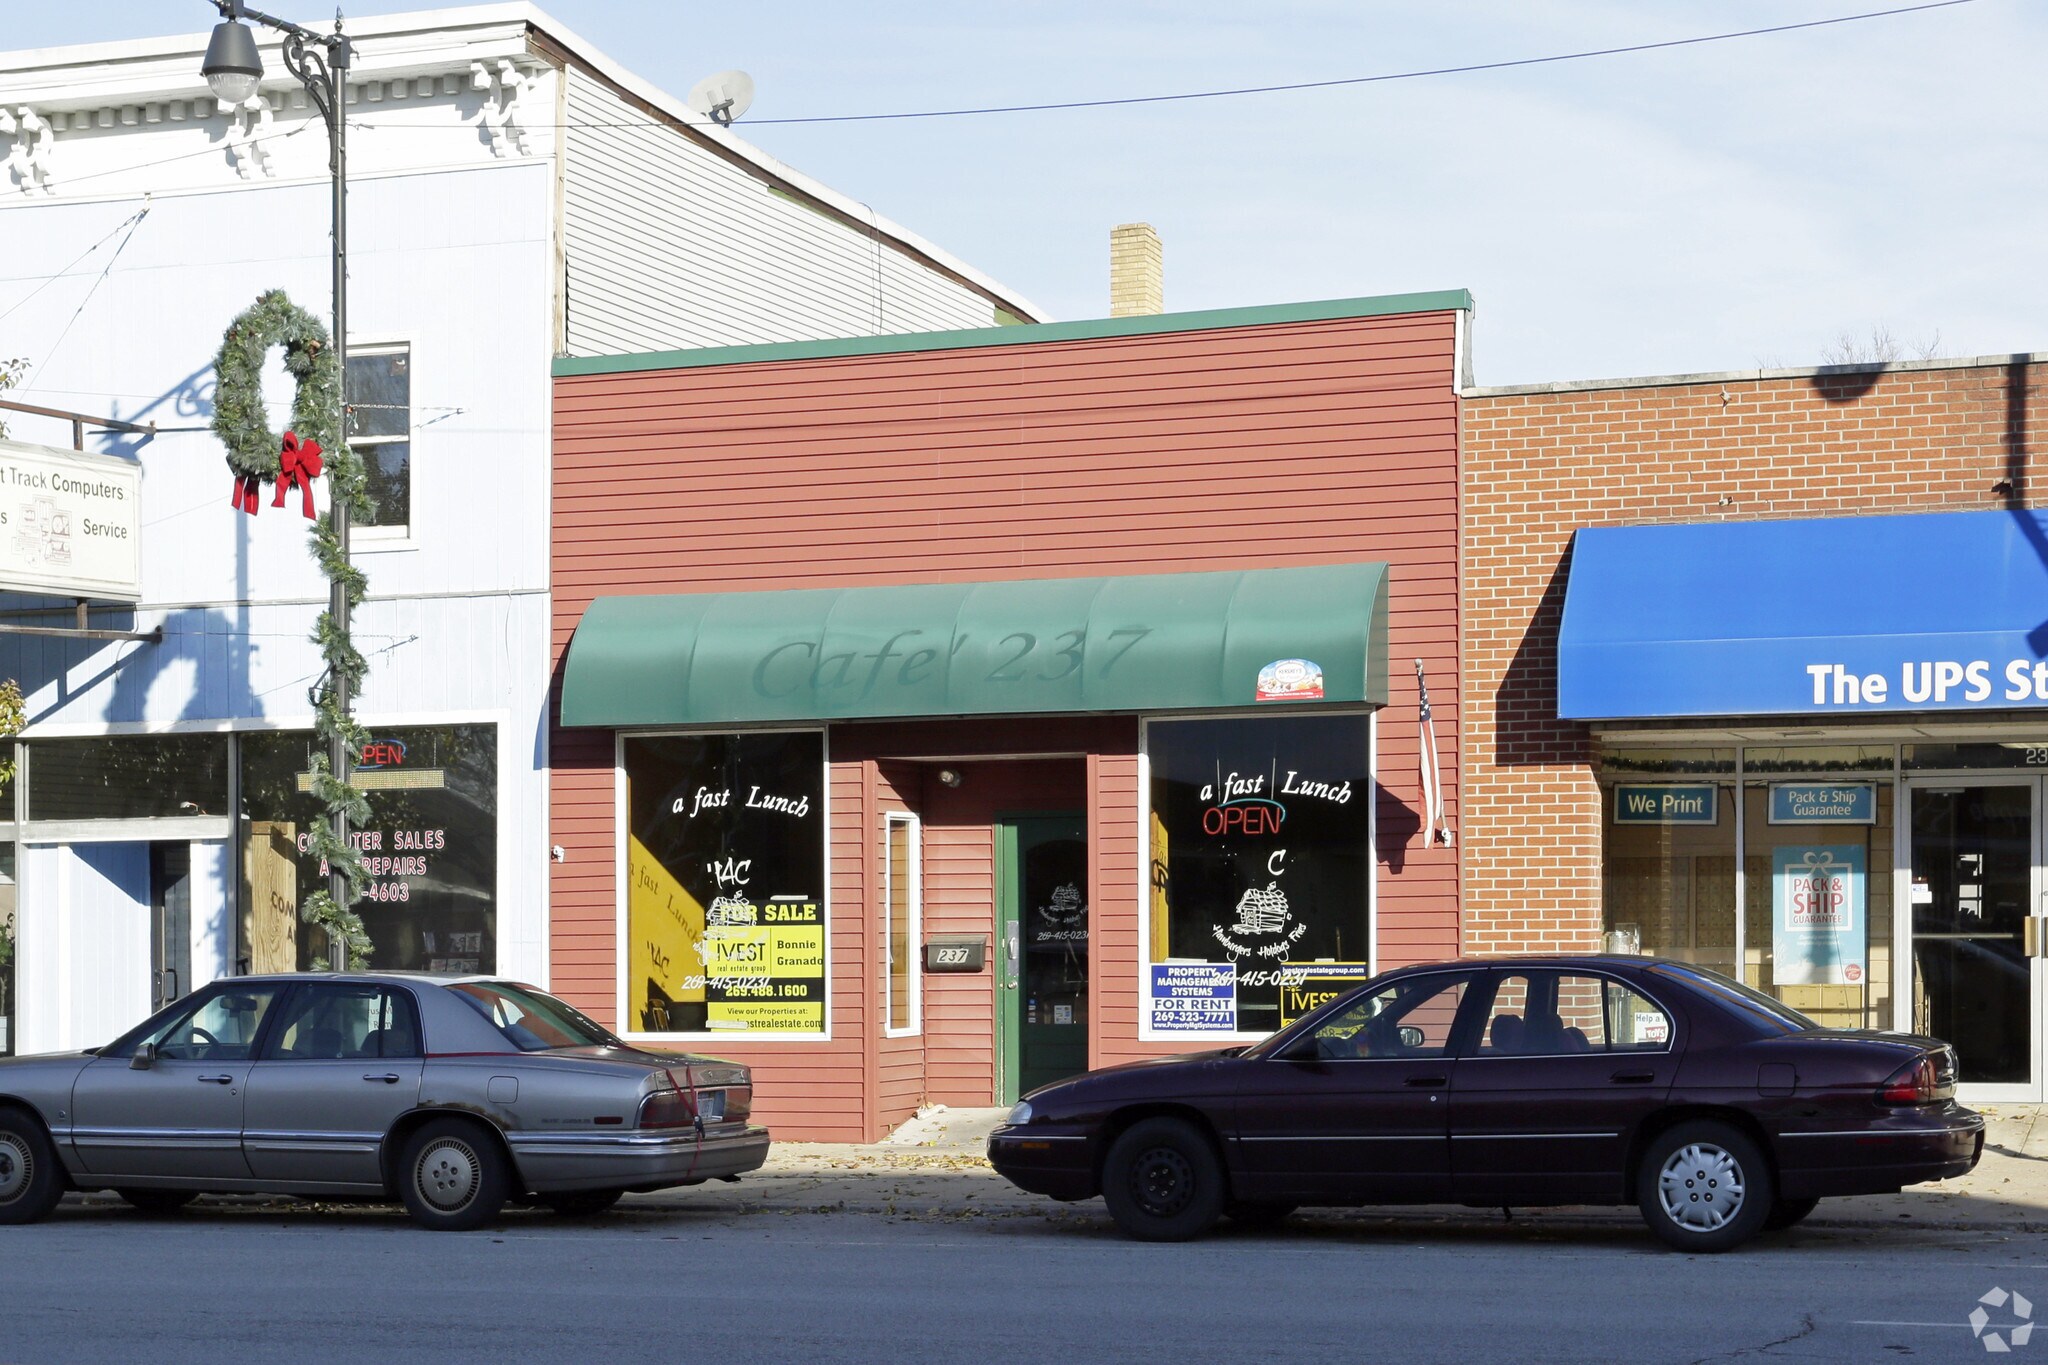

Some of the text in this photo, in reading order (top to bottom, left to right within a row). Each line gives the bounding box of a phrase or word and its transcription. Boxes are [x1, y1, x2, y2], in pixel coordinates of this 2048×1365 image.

[10, 467, 47, 489] Track
[52, 473, 124, 500] Computers
[83, 518, 127, 539] Service
[985, 629, 1154, 682] 237
[1806, 663, 1888, 704] The
[1902, 660, 1992, 703] UPS
[362, 745, 402, 765] PEN
[1200, 771, 1352, 804] a fast Lunch
[672, 785, 810, 818] a fast Lunch
[1628, 795, 1703, 813] We Print
[1789, 790, 1857, 805] Pack & Ship
[1793, 804, 1852, 816] Guarantee
[1203, 806, 1281, 835] OPEN
[394, 830, 445, 850] SALES
[1793, 877, 1843, 892] PACK &
[1793, 893, 1843, 914] SHIP
[765, 904, 816, 921] SALE
[1793, 915, 1842, 923] GUARANTEE
[777, 940, 816, 949] Bonnie
[777, 956, 823, 966] Granado
[938, 950, 968, 962] 237
[751, 965, 766, 974] group
[1168, 967, 1217, 977] PROPERTY
[1171, 987, 1213, 996] SYSTEMS
[1155, 999, 1231, 1010] FOR RENT
[760, 1008, 797, 1017] Properties
[1154, 1011, 1230, 1022] 269-323-7771
[1636, 1014, 1653, 1023] Help
